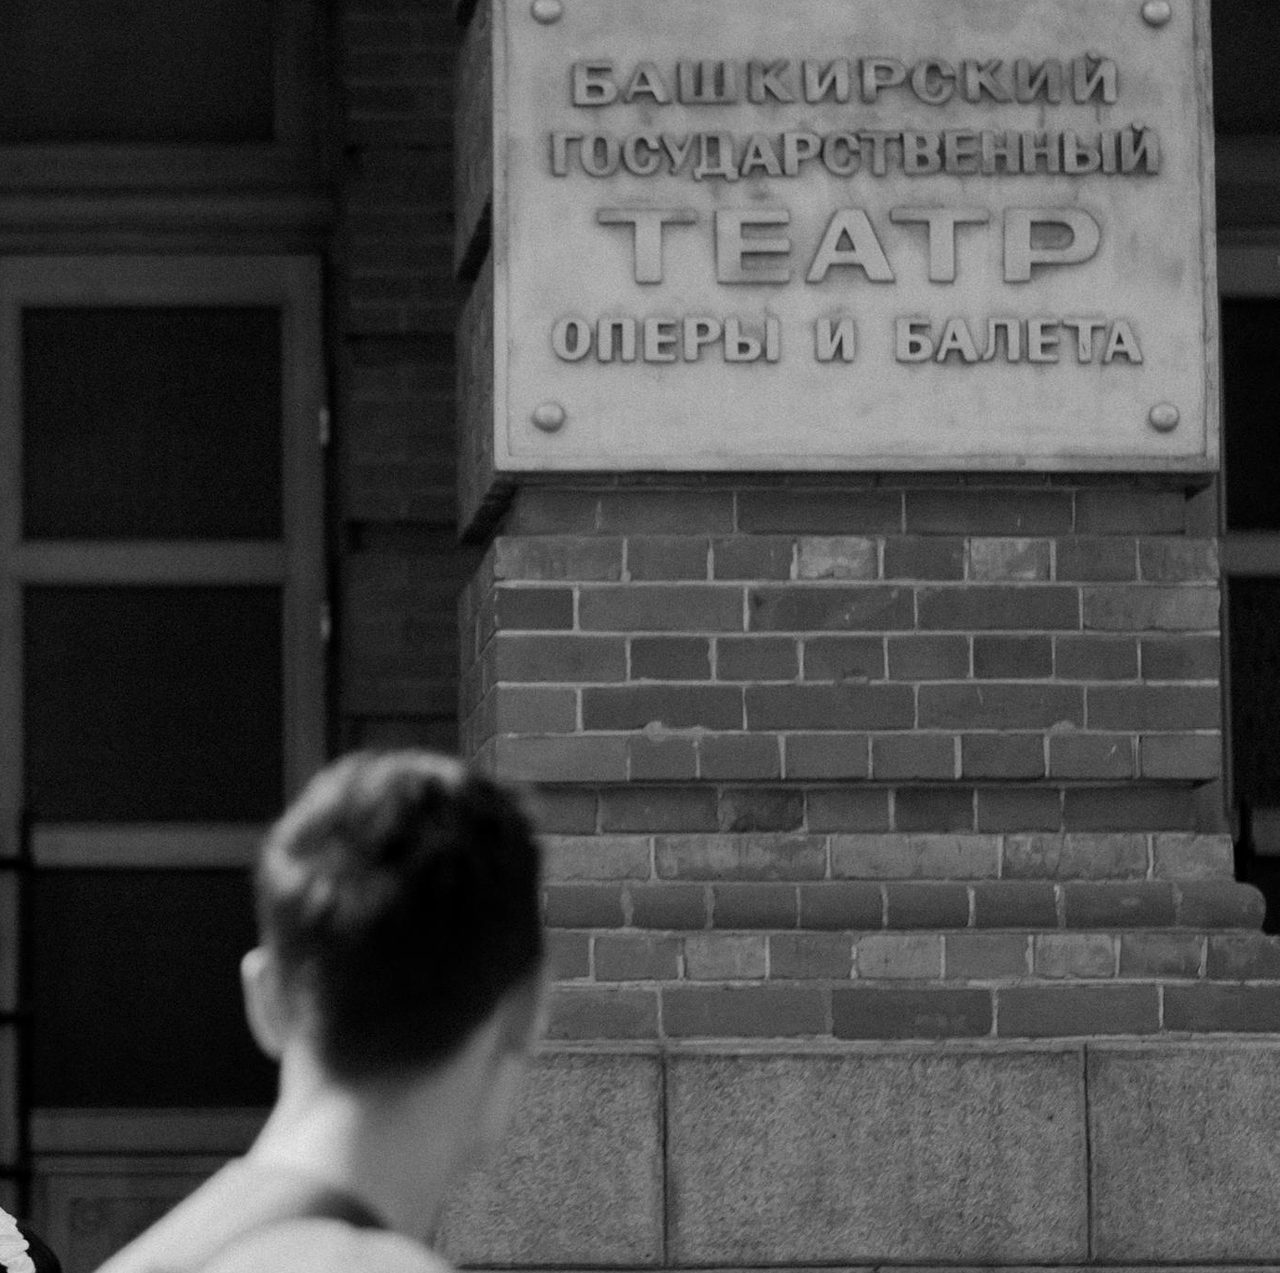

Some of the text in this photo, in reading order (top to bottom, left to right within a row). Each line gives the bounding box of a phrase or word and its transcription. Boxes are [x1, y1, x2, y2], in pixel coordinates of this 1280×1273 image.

[569, 51, 1120, 108] БАШКИРСКИЙ
[548, 123, 1162, 182] ГОСУДАРСТВЕННЫЙ
[596, 207, 1103, 285] ТЕАТР
[551, 316, 1144, 365] ОПЕРЫ И БАЛЕТА
